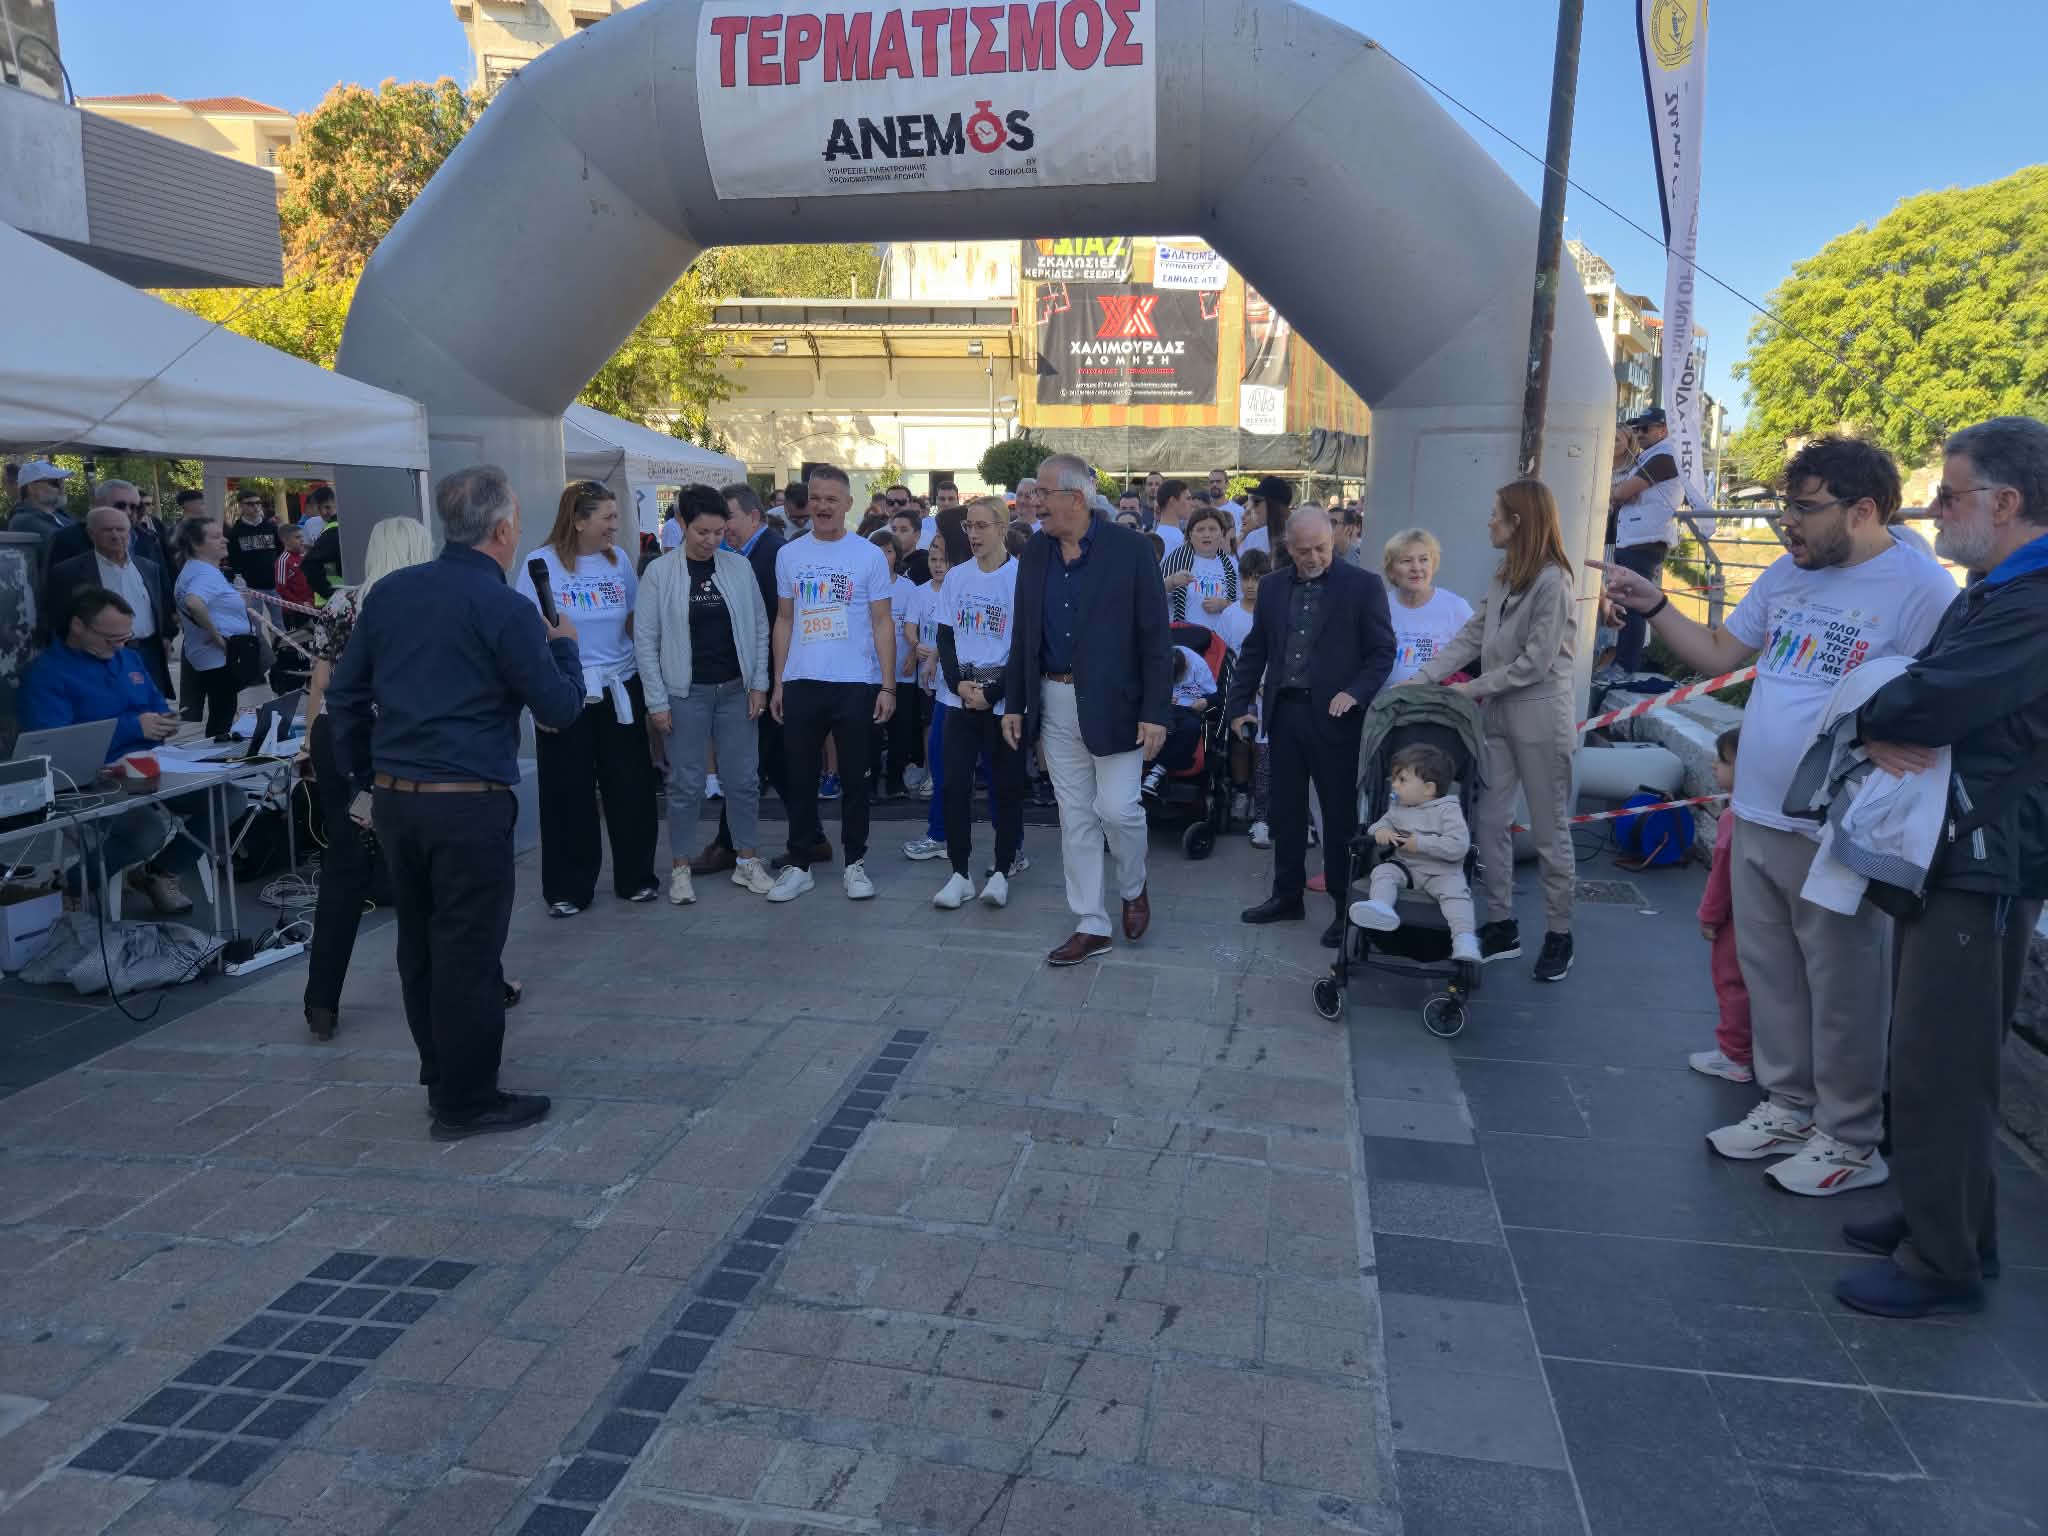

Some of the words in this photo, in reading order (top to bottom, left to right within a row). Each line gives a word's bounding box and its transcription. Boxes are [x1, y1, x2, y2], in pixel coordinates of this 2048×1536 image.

[710, 0, 1143, 88] ΤΕΡΜΑΤΙΣΜΟΣ
[1037, 257, 1117, 269] ΣΚΑΛΩΣΙΕΣ
[1070, 341, 1185, 354] ΧΑΛΙΜΟΥΡΔΑΣ
[1830, 622, 1861, 638] ΟΛΟΙ
[1824, 631, 1855, 647] ΜΑΖΙ
[1826, 642, 1850, 657] ΤΡΕ
[1818, 651, 1846, 666] ΧΟΥ
[1822, 663, 1841, 677] ΜΕ
